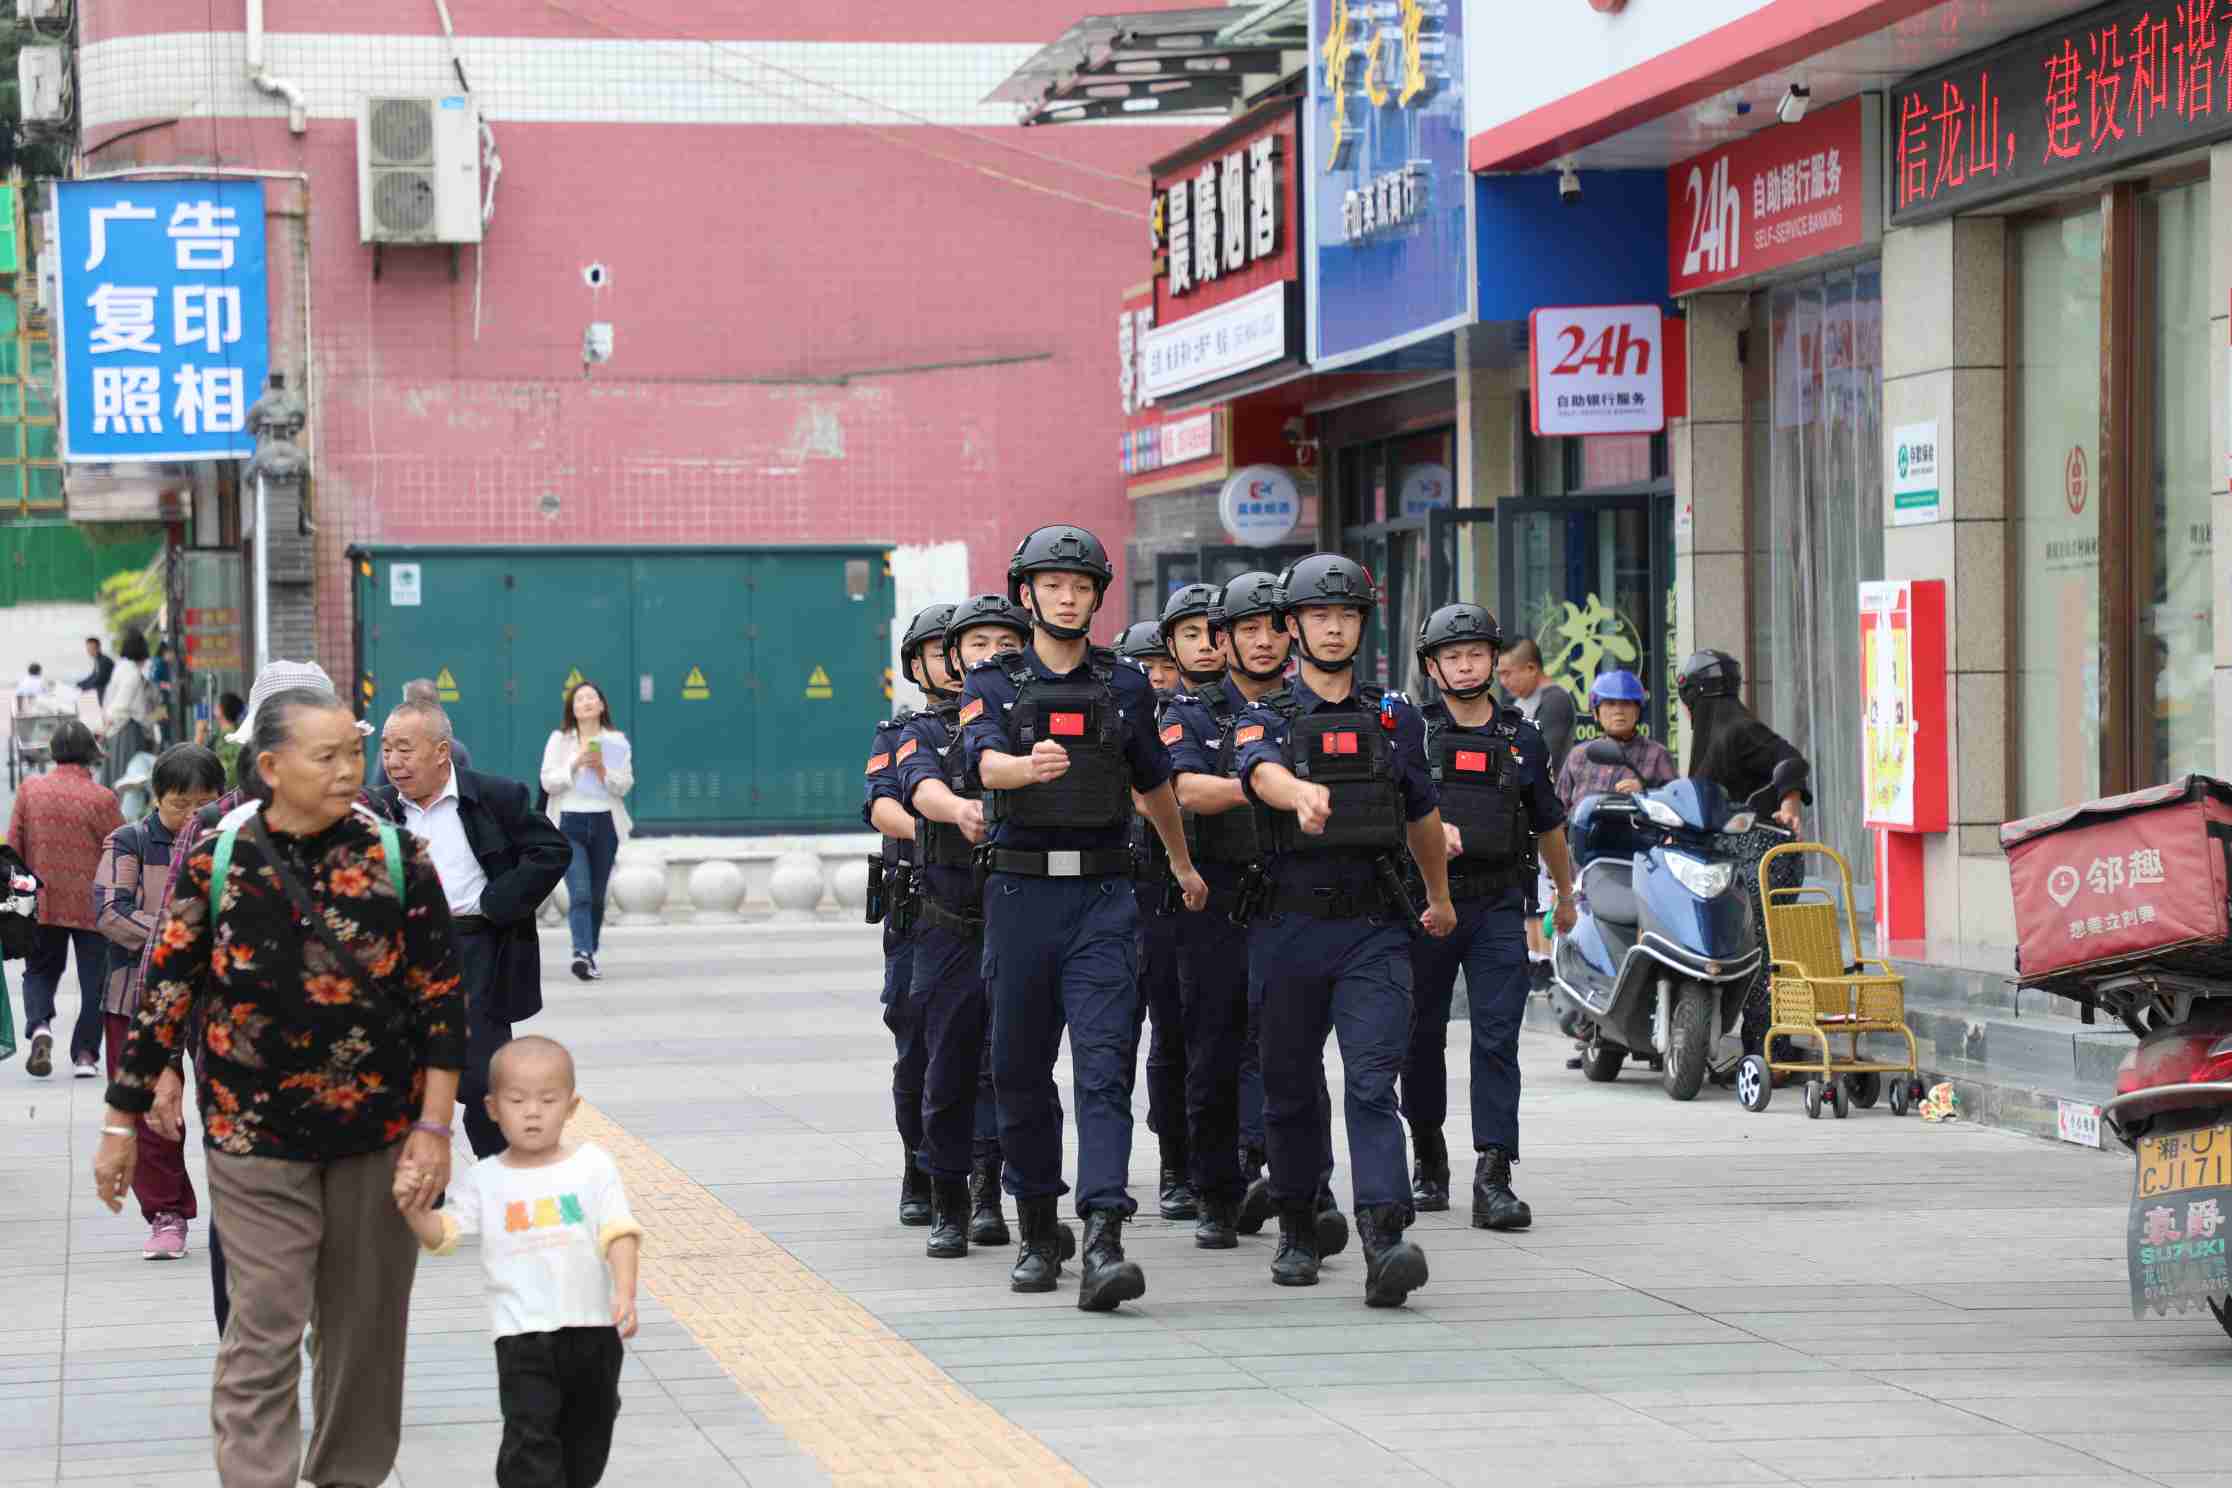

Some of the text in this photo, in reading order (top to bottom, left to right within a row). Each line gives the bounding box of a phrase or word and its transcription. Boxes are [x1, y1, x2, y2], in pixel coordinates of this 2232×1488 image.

[1896, 0, 2232, 208] 信龙山，建设和谐
[1753, 147, 1842, 220] 自助银行服务
[85, 200, 241, 273] 广告
[1682, 155, 1742, 277] 24h
[1753, 214, 1809, 250] SELF-SERVICE
[86, 283, 242, 355] 复印
[1550, 323, 1651, 377] 24h
[91, 365, 244, 436] 照相
[1557, 391, 1646, 409] 自助银行服务
[2086, 848, 2166, 895] 邻趣
[2069, 905, 2156, 939] 想要立刻要
[2143, 1153, 2222, 1193] CJ171
